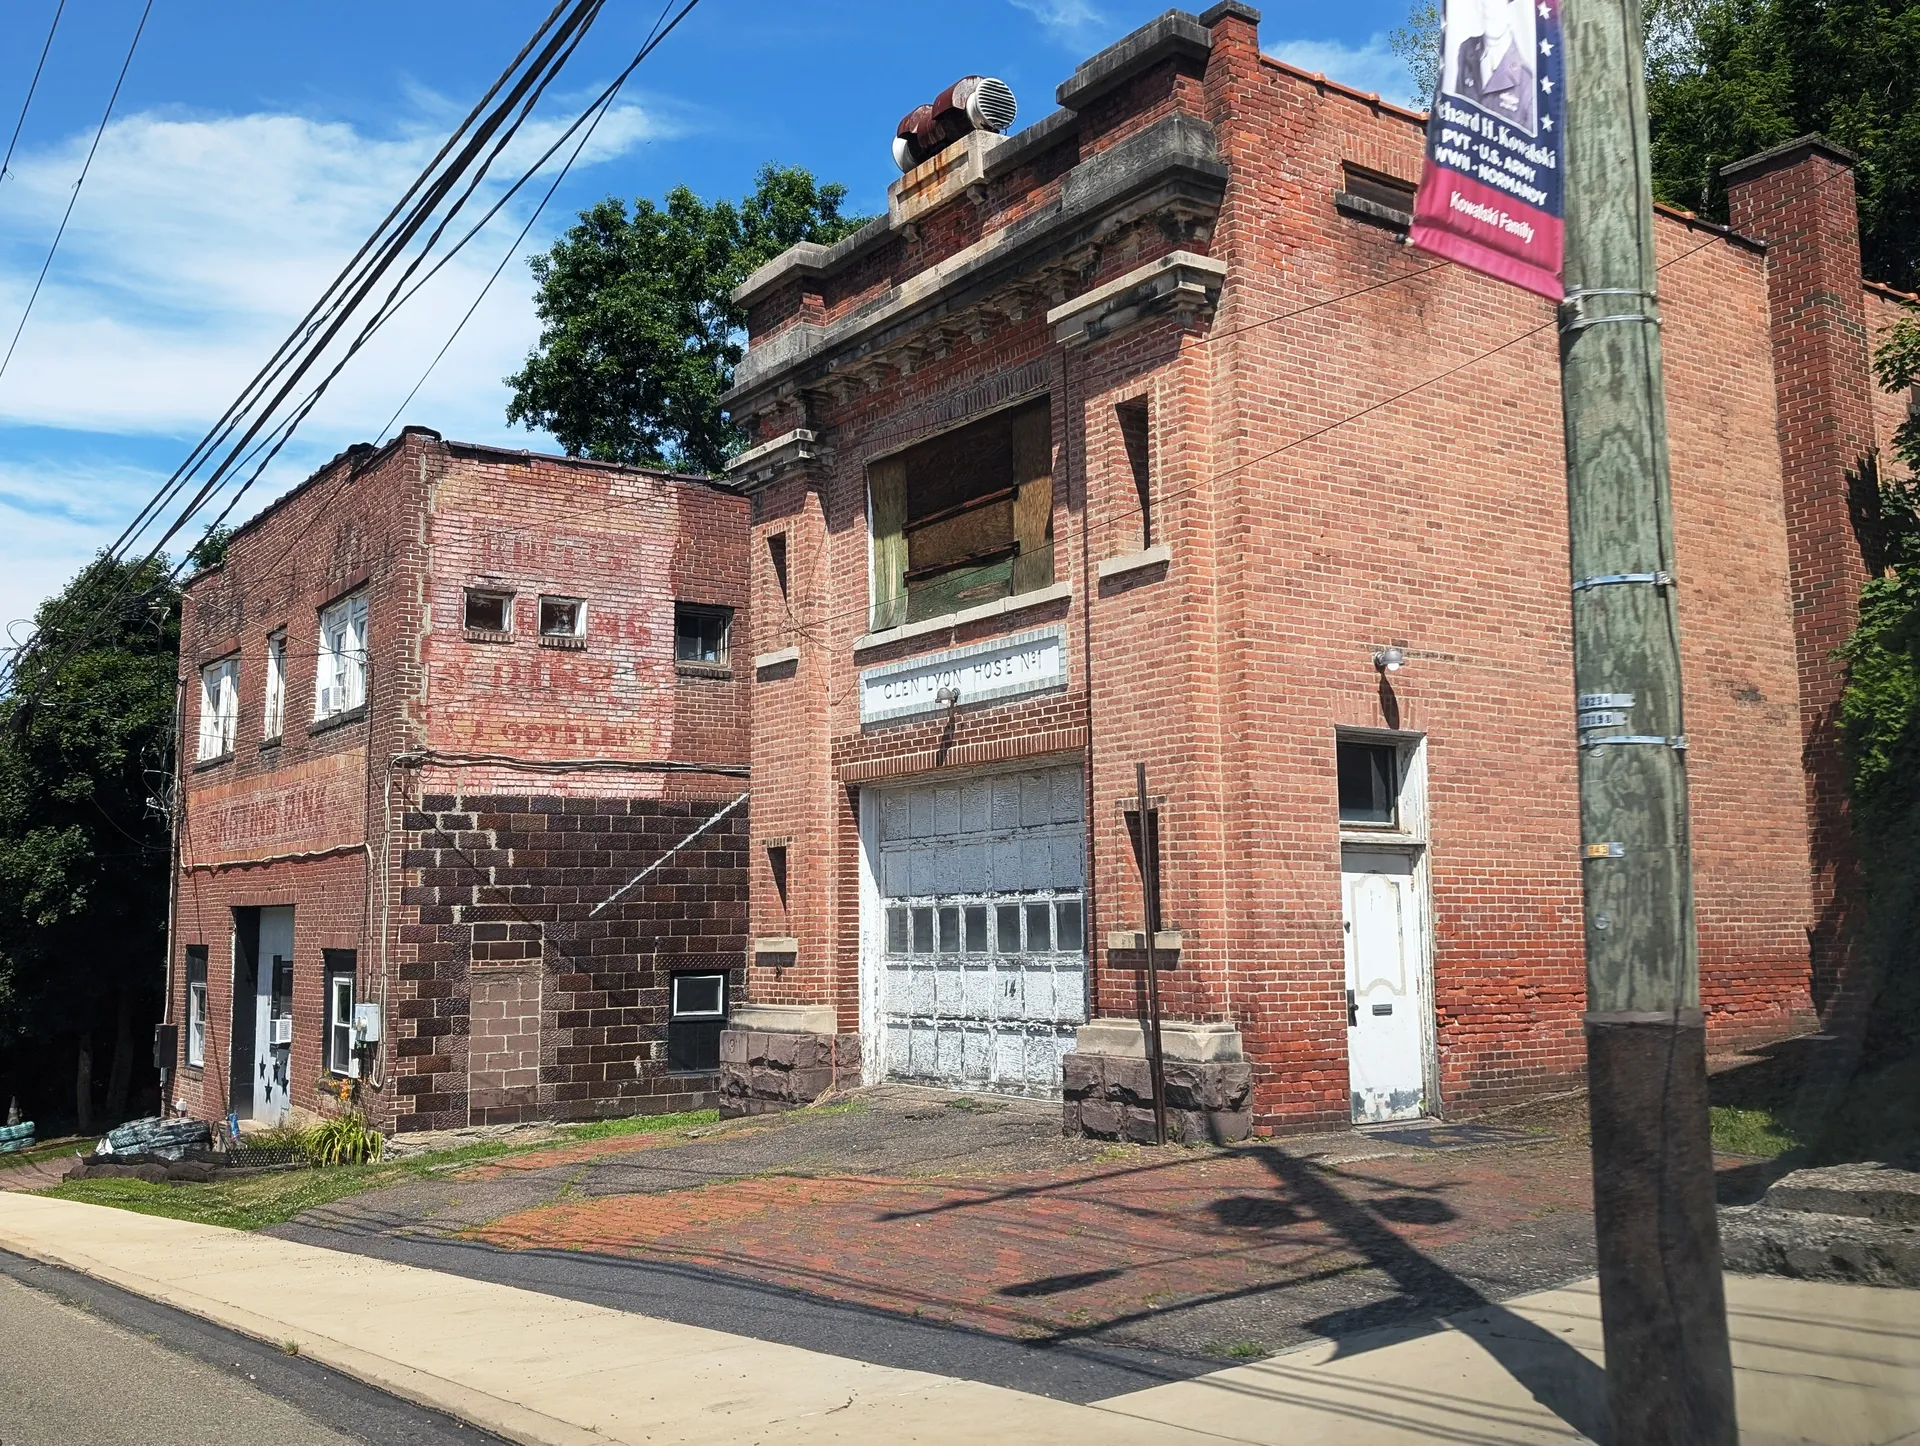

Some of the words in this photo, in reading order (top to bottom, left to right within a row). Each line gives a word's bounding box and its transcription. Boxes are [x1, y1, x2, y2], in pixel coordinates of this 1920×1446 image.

[1441, 128, 1471, 150] PVT
[1503, 156, 1536, 183] ARMY
[1498, 124, 1556, 169] Kowalski
[1478, 163, 1548, 206] NORMANDY
[1450, 190, 1499, 227] Kowalski
[1499, 212, 1534, 244] Family
[926, 667, 962, 691] LYON
[974, 656, 1013, 681] HOSE
